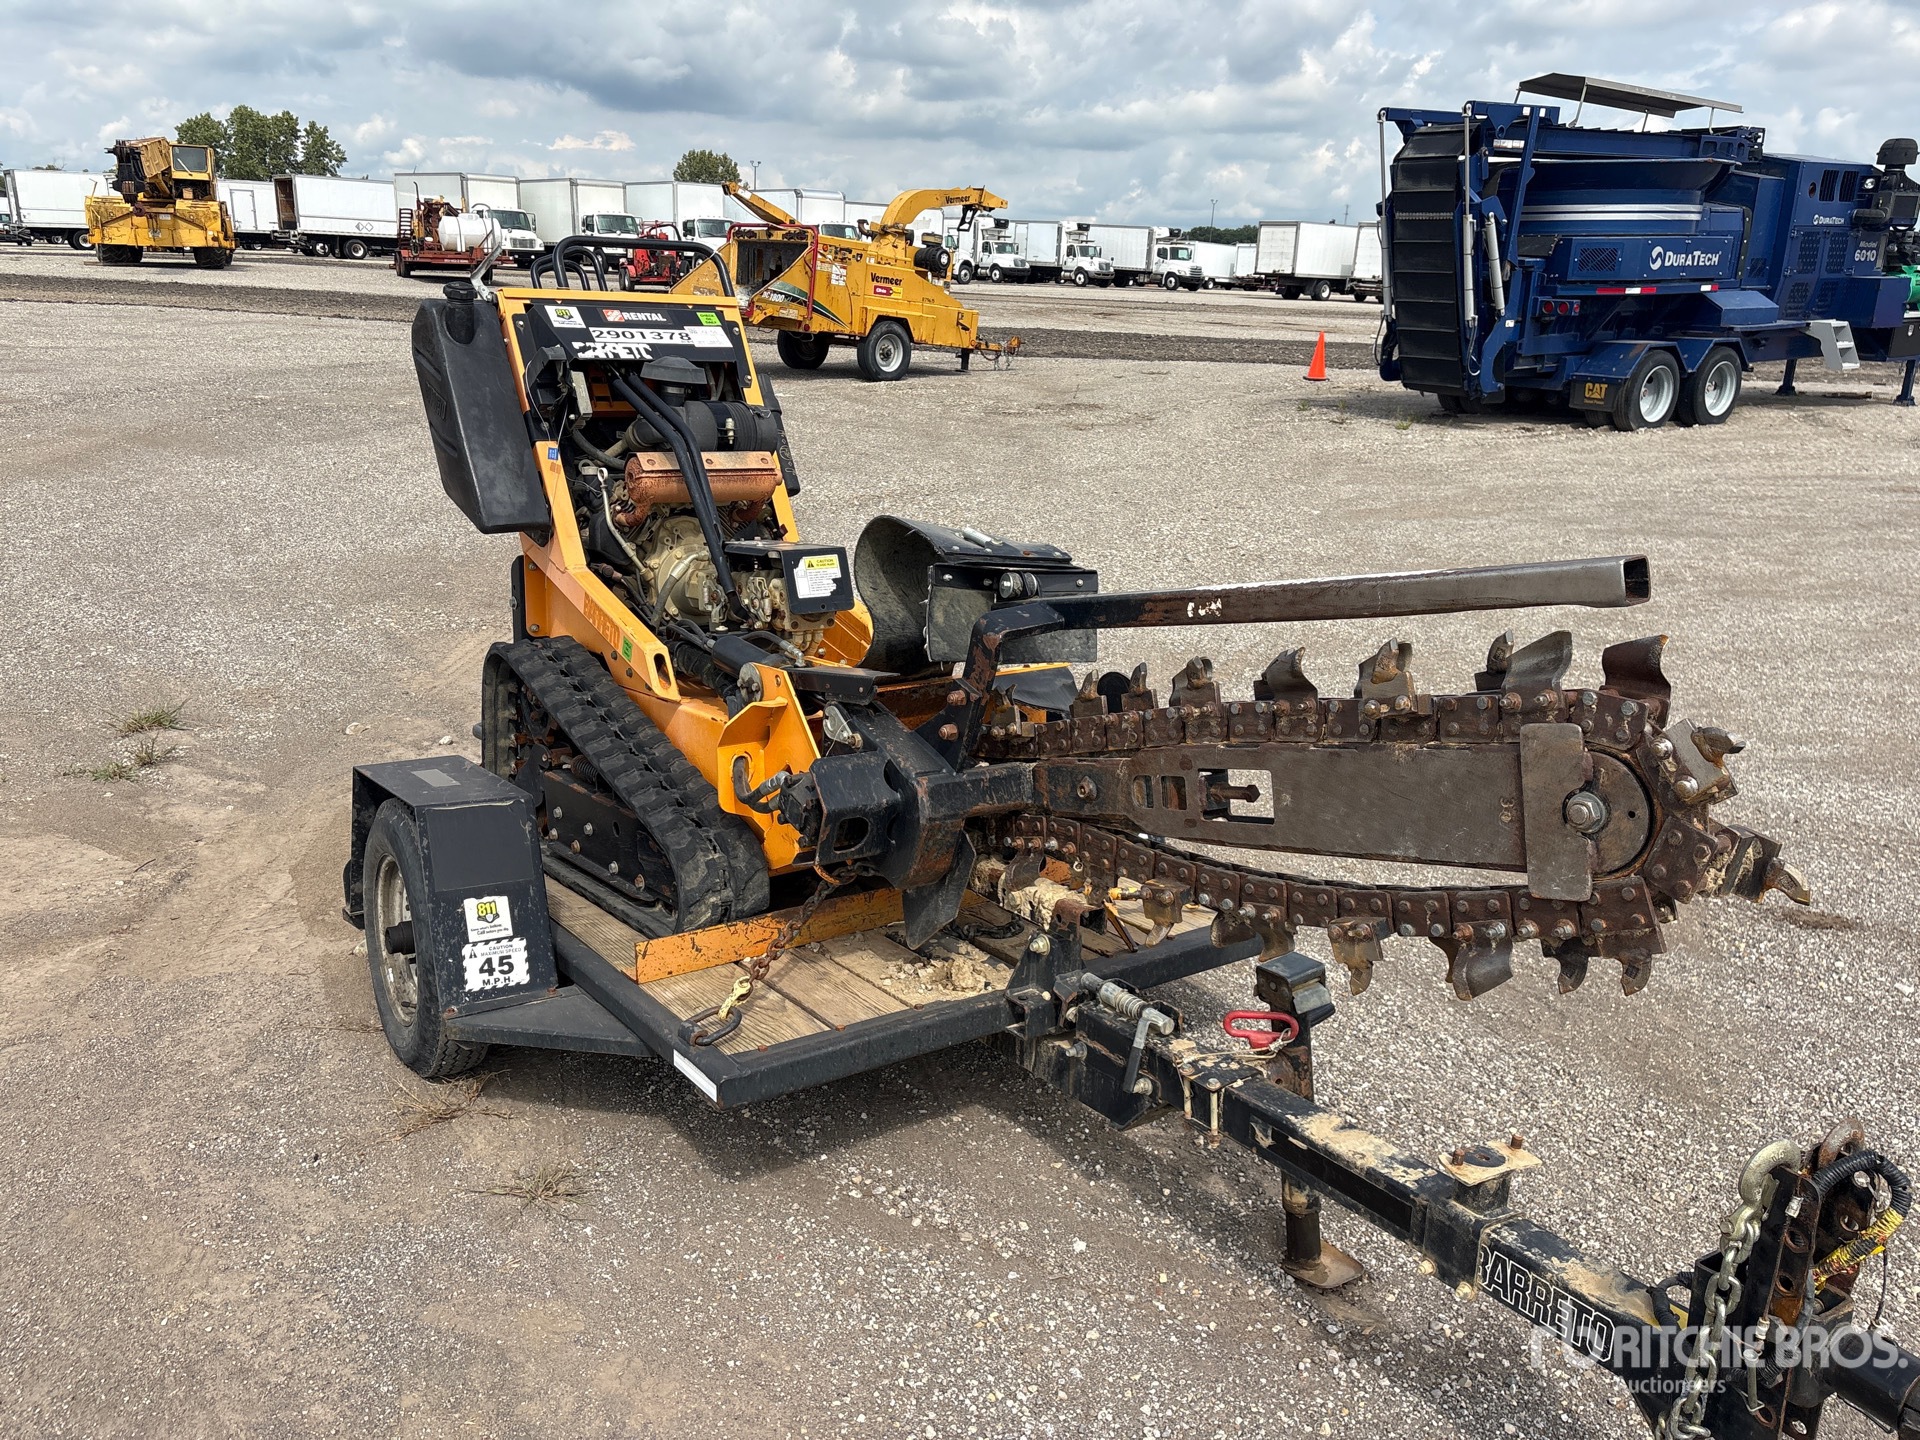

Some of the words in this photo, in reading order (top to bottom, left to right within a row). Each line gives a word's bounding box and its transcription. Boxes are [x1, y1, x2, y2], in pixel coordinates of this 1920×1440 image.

[945, 195, 971, 204] Vermeer
[1854, 249, 1877, 262] 6010
[870, 272, 903, 286] Vermeer
[622, 312, 667, 321] RENTAL
[592, 330, 691, 340] 2901378
[1585, 382, 1608, 399] CAT
[477, 901, 497, 917] 811
[479, 955, 514, 976] 45
[482, 976, 514, 986] M.P.H.
